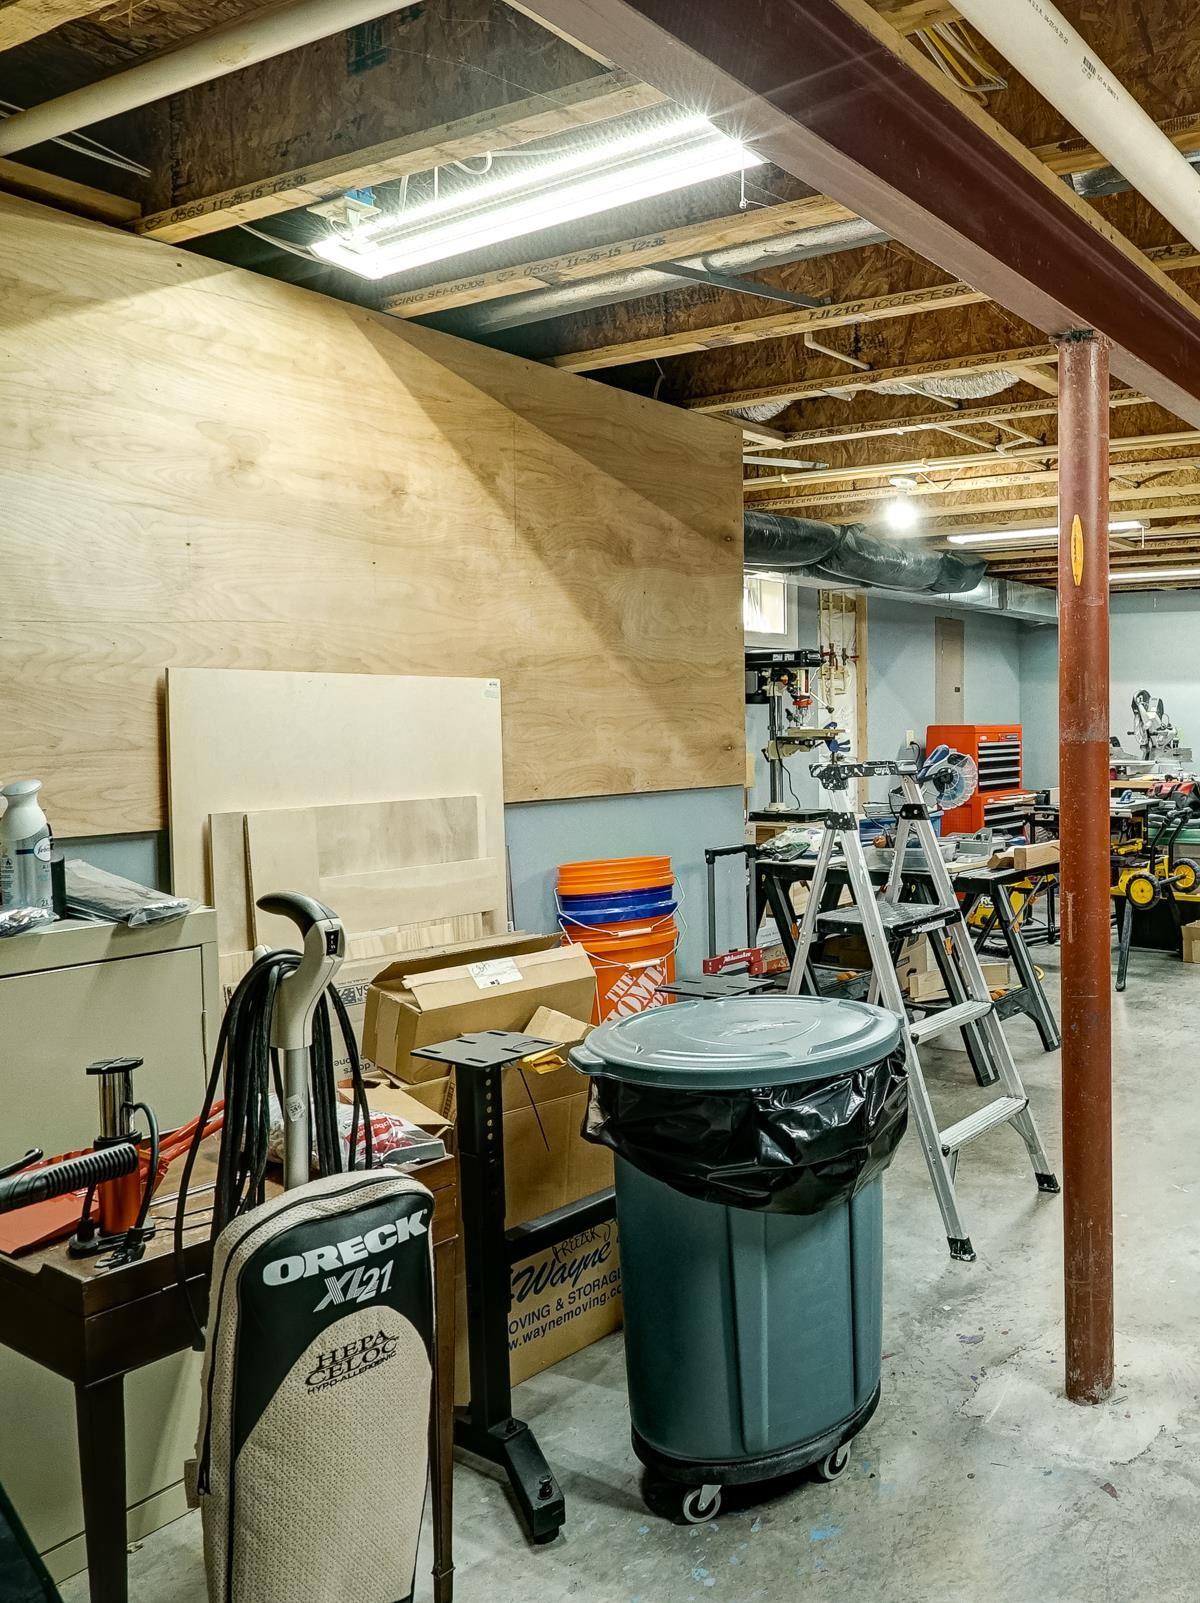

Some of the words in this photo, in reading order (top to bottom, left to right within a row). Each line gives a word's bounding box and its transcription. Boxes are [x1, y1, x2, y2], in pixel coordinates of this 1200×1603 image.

[872, 293, 924, 311] ICCES
[605, 971, 637, 1003] THE
[262, 1210, 428, 1287] ORECK
[511, 1241, 612, 1303] Wayne
[312, 1259, 394, 1313] XL21
[508, 1304, 551, 1335] OVING
[555, 1298, 565, 1312] &
[508, 1284, 622, 1351] w.waynemoving.co
[304, 1335, 400, 1387] CELOC
[307, 1350, 398, 1395] HYPO-ALLERGENIC
[316, 1329, 390, 1371] HEPA
